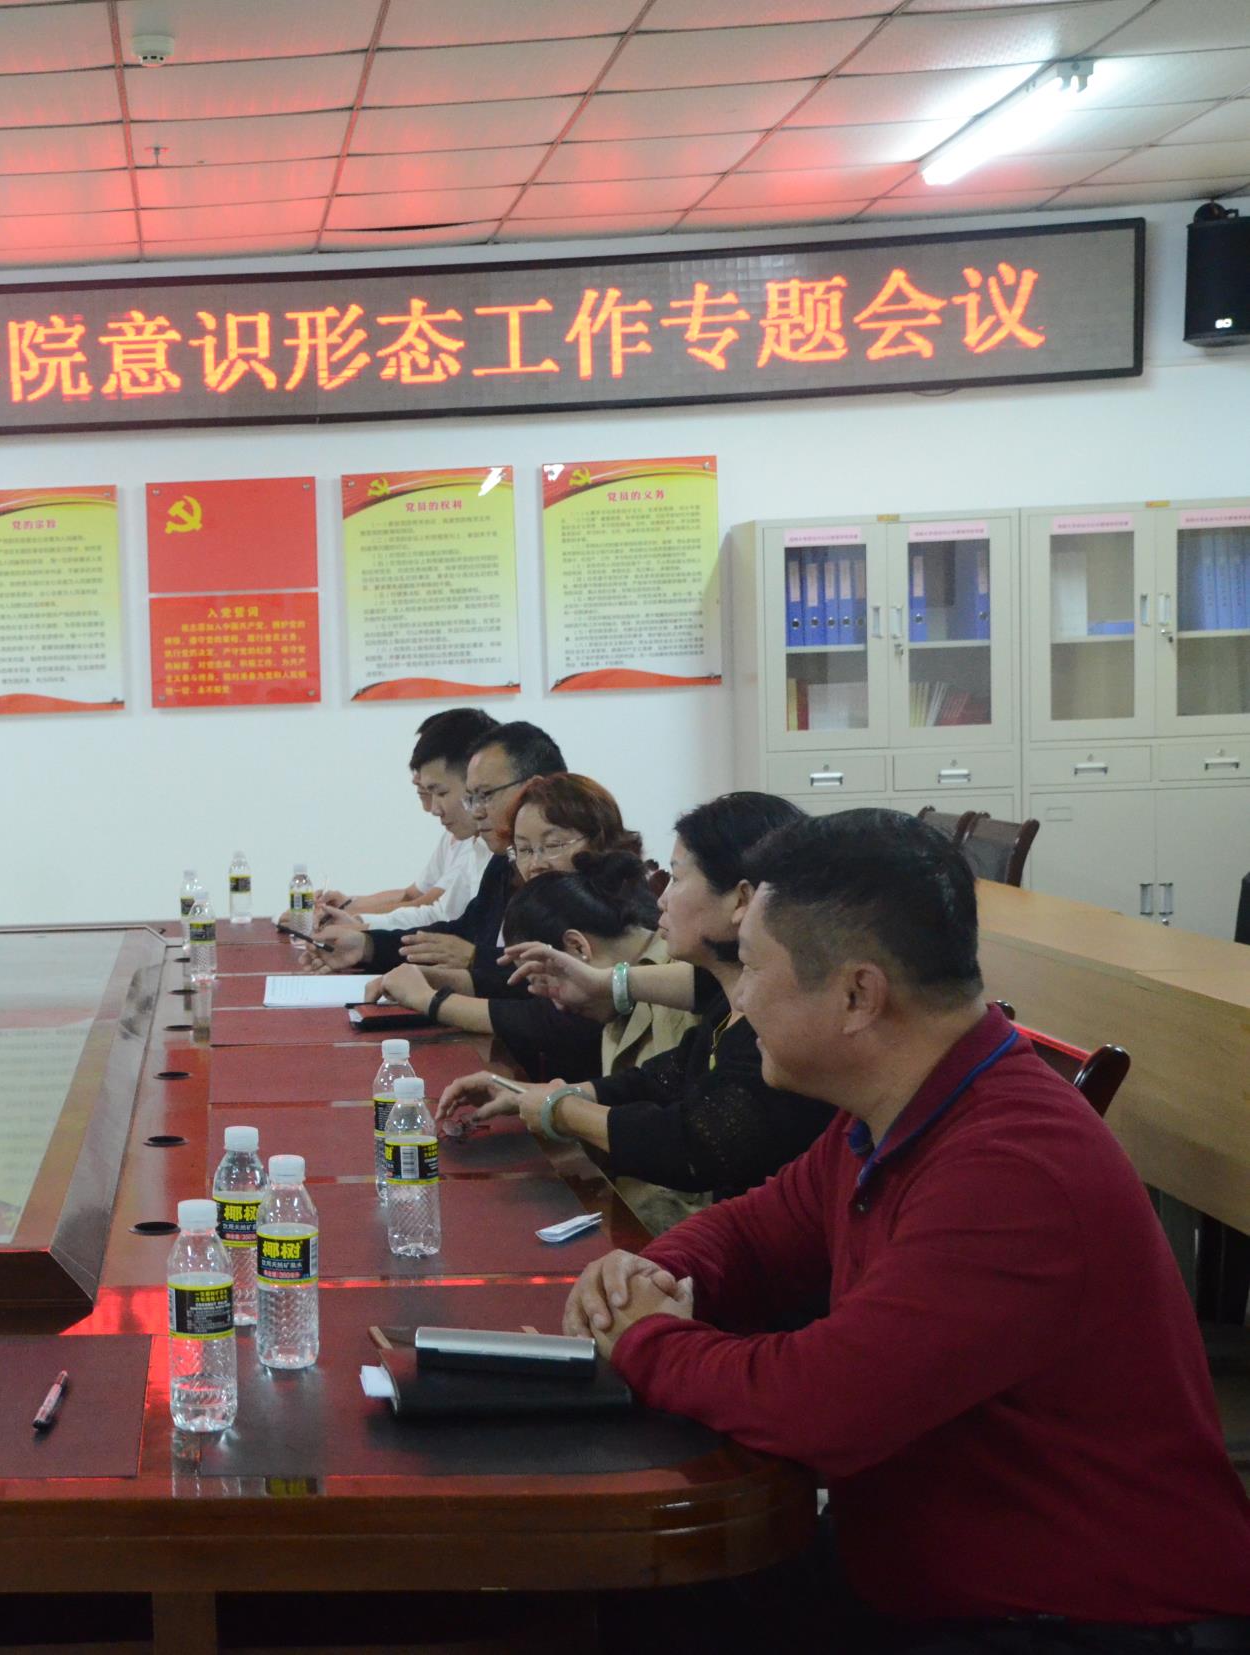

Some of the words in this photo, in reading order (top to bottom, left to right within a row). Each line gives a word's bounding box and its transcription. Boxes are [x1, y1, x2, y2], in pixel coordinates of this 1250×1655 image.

[606, 489, 665, 503] 党员的义务
[404, 499, 463, 512] 党员的权利
[11, 519, 58, 530] 党的宗旨
[261, 1240, 301, 1259] 椰树
